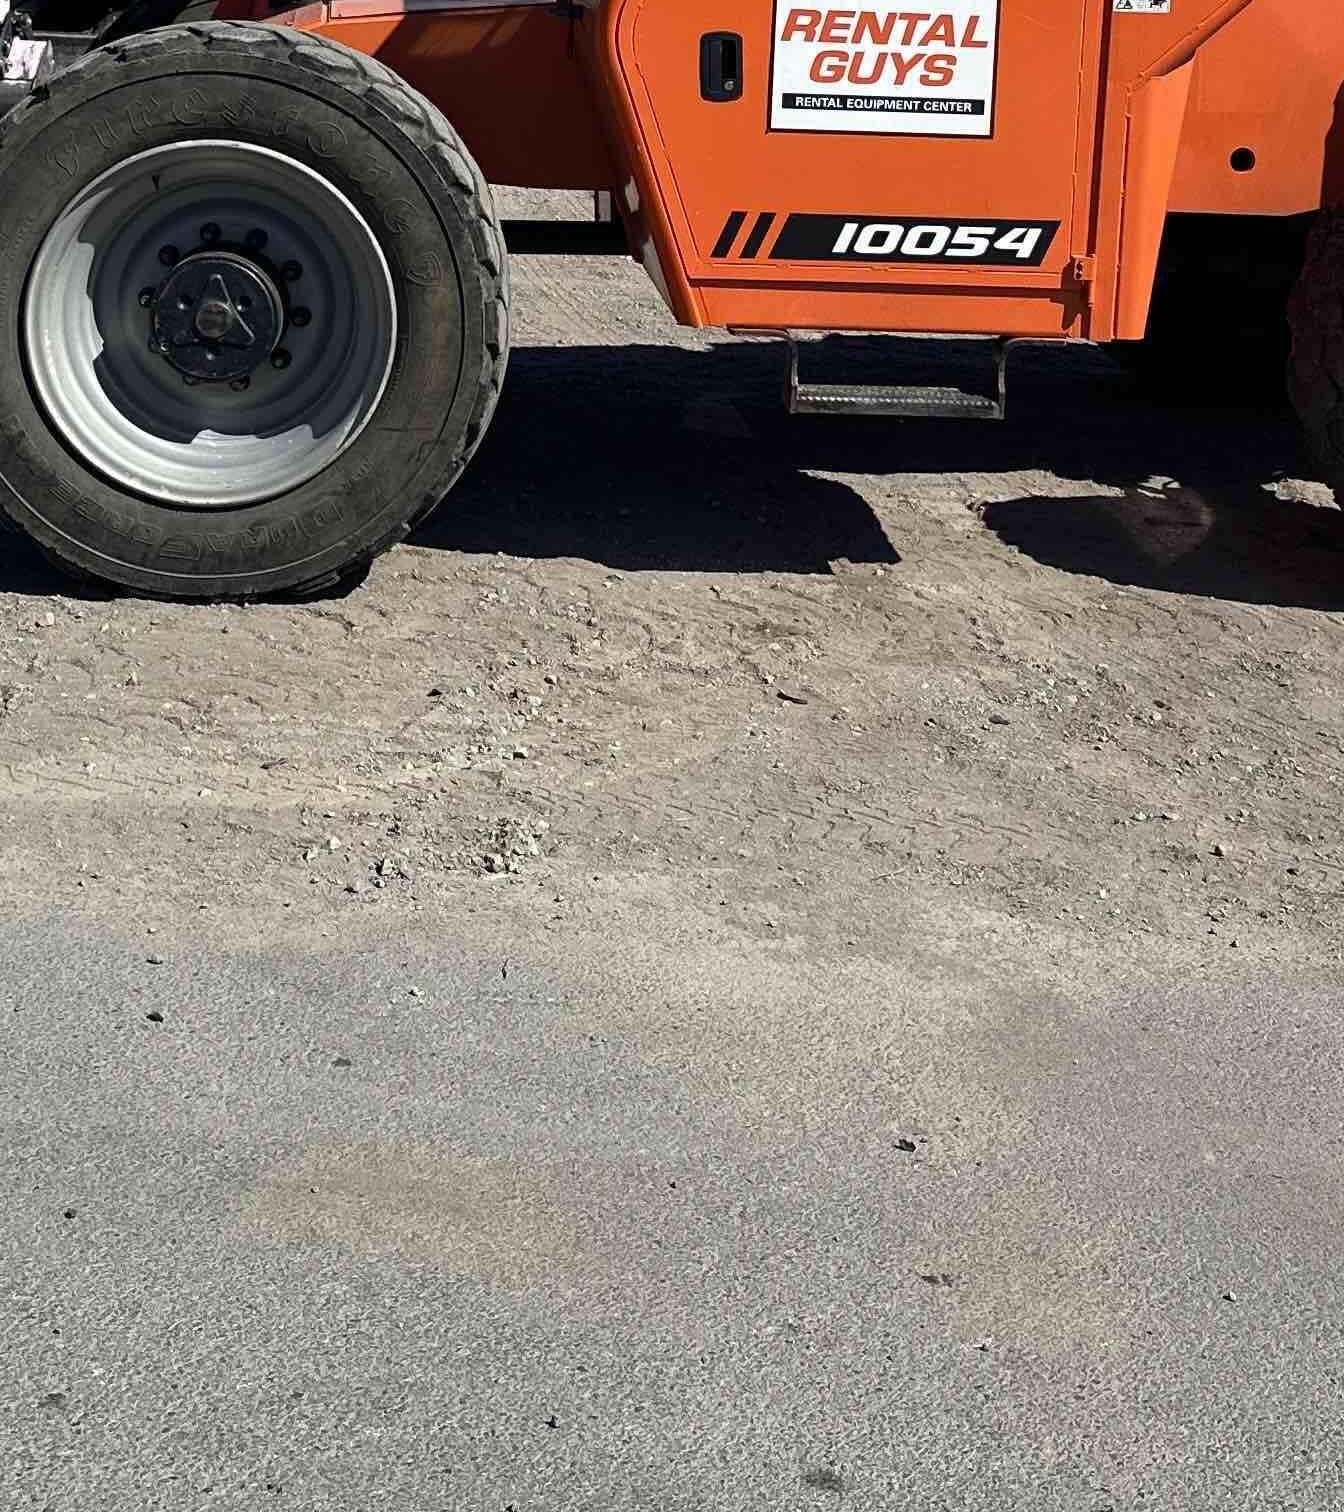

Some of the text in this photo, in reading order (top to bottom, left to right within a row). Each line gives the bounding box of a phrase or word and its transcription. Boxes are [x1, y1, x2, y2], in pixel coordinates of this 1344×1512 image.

[780, 9, 989, 49] RENTAL
[809, 50, 958, 87] GUYS
[795, 96, 973, 114] RENTAL EQUIPMENT CENTER
[832, 222, 1043, 259] 10054
